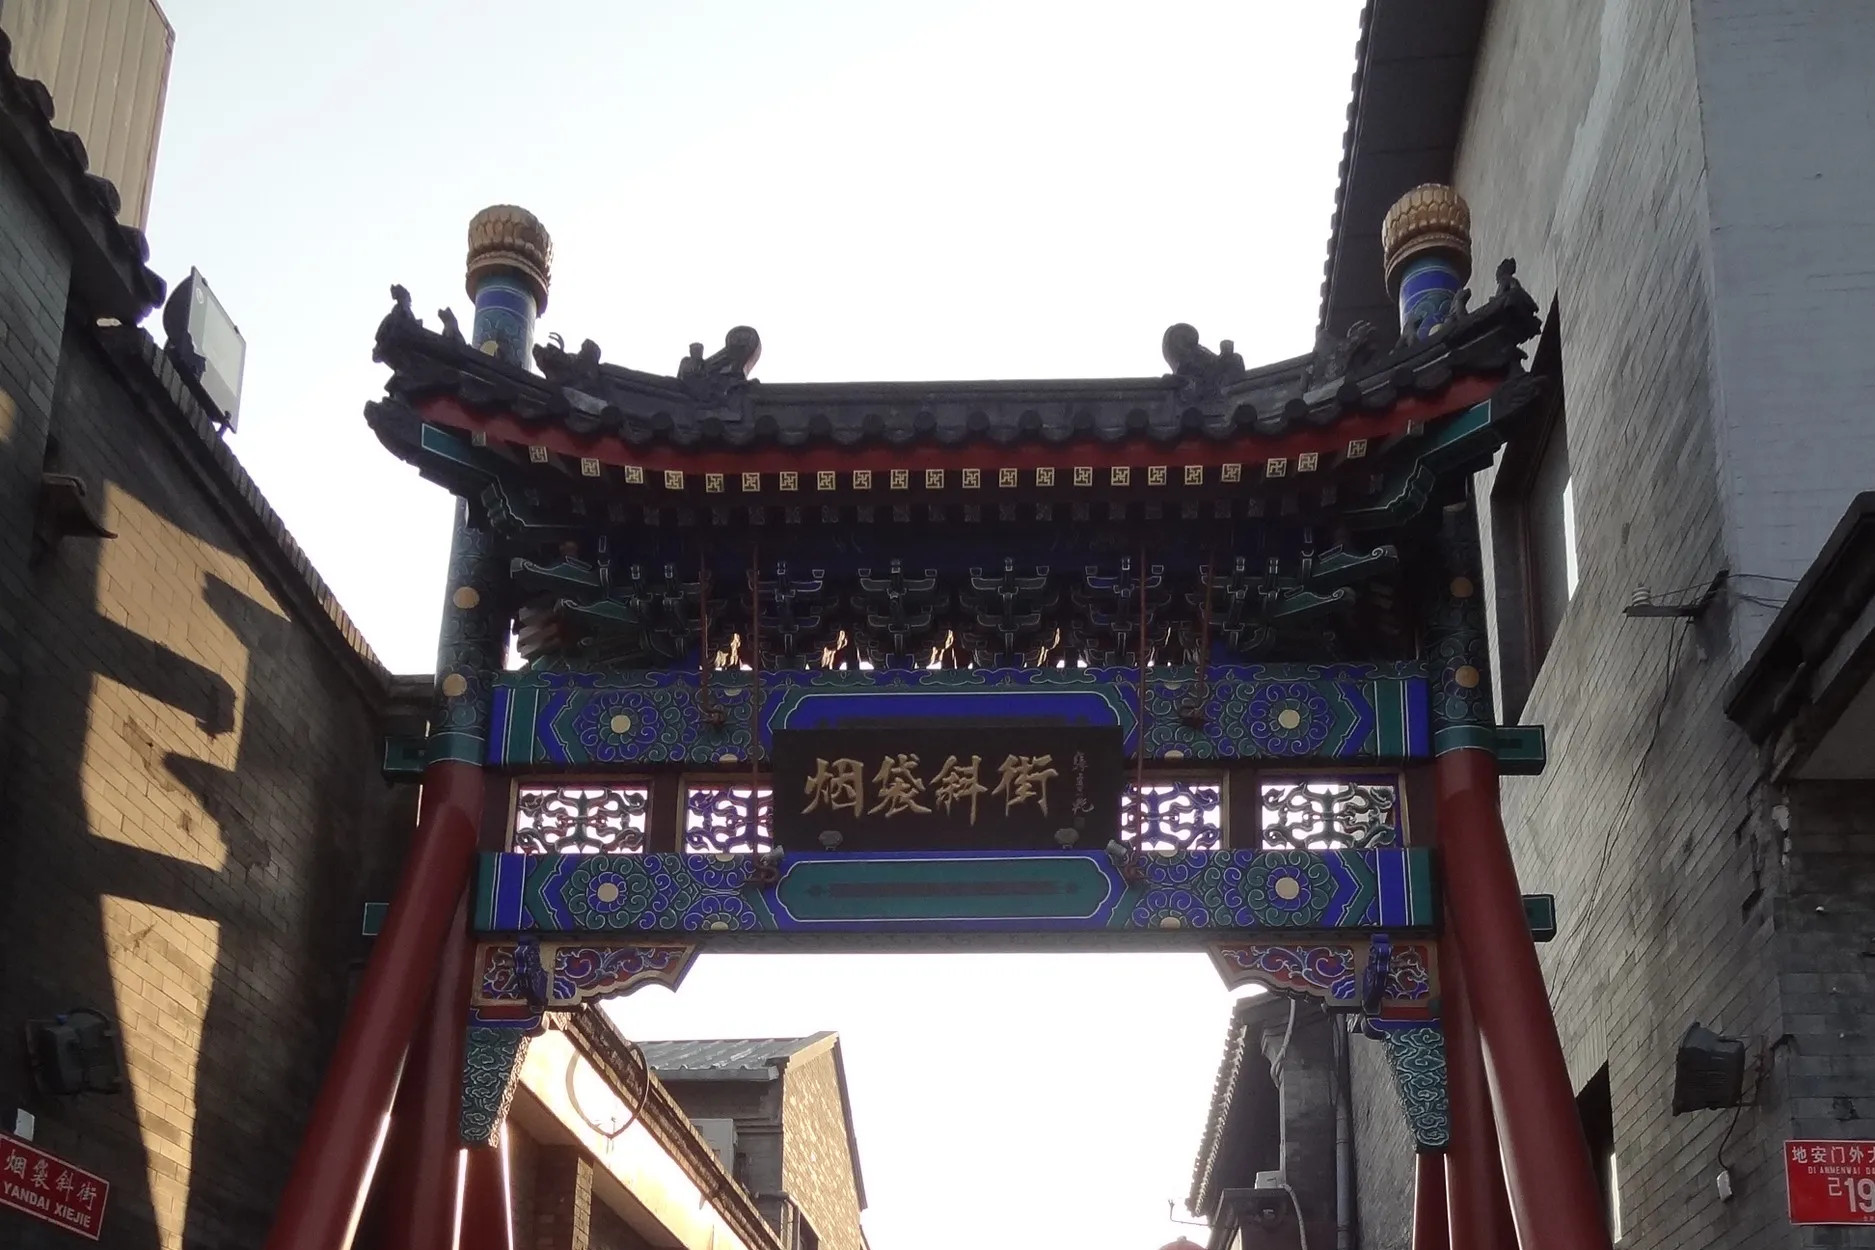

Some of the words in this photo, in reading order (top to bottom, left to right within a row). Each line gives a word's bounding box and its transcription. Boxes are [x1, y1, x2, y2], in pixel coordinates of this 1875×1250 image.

[801, 753, 1059, 826] 烟袋斜街
[3, 1181, 51, 1211] YANDAI
[54, 1203, 92, 1228] XIEJIE
